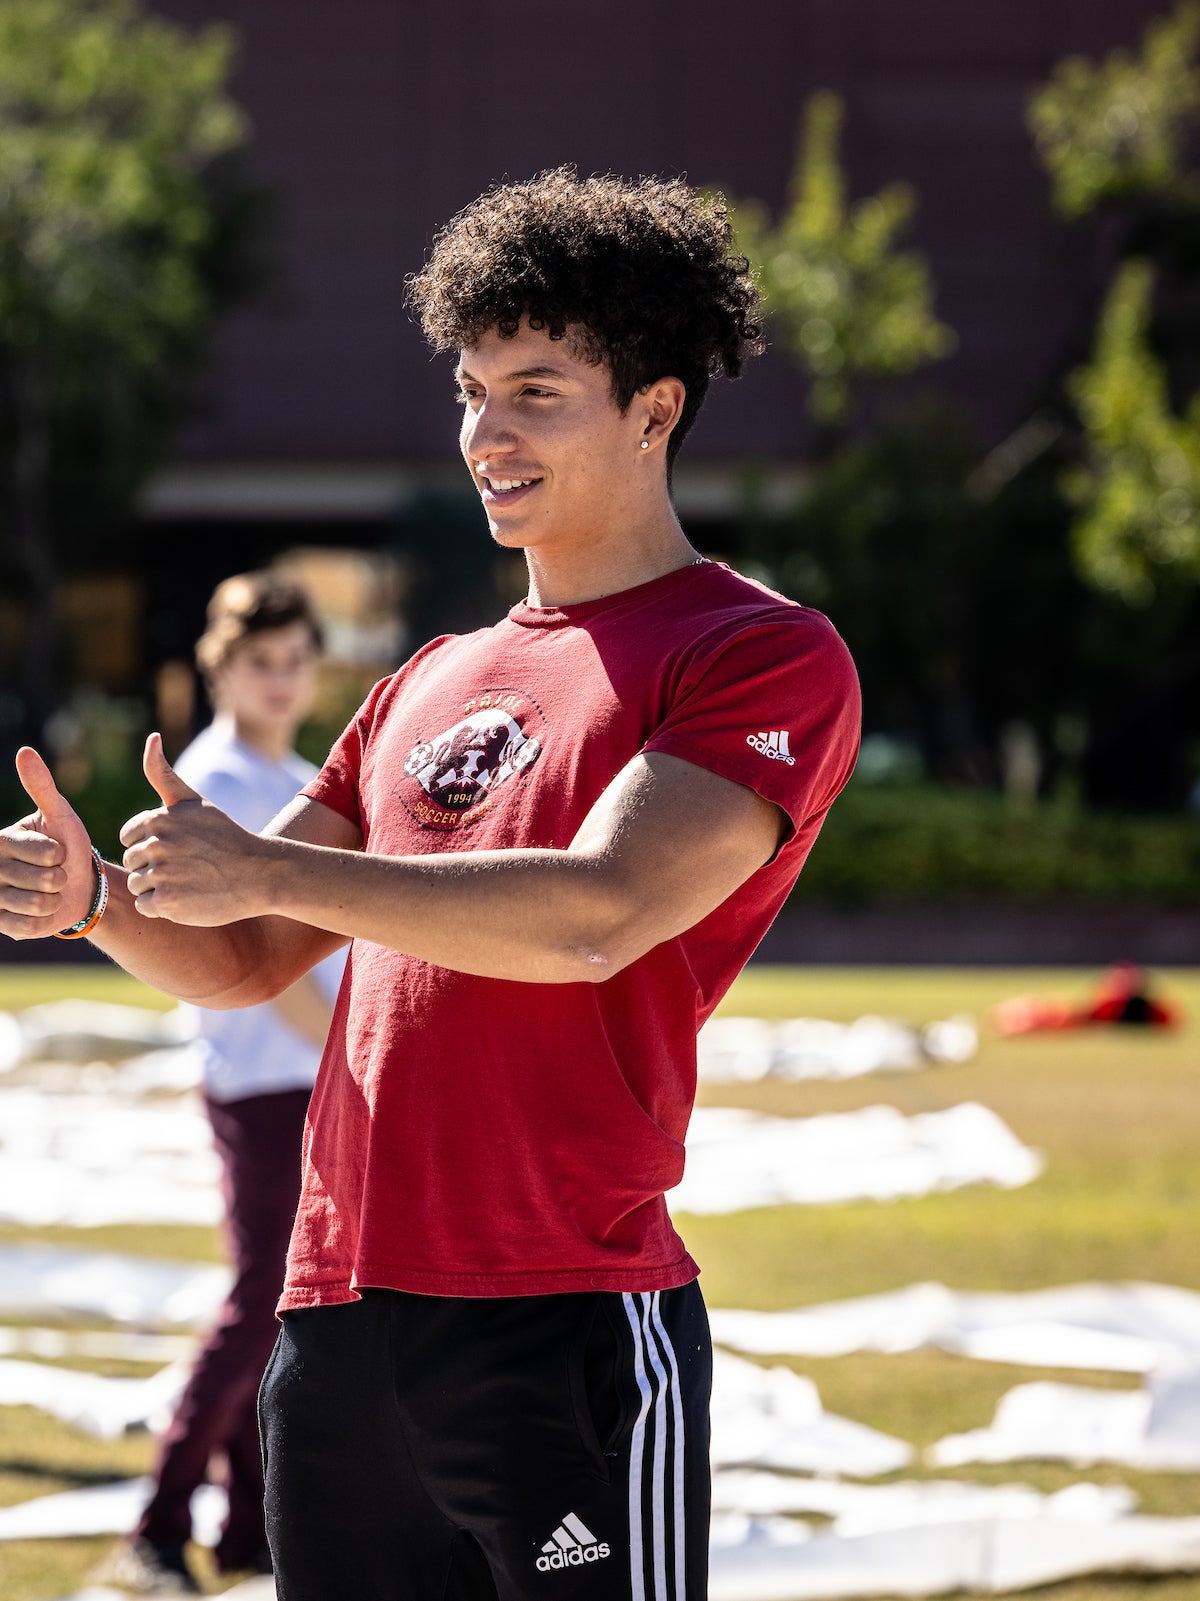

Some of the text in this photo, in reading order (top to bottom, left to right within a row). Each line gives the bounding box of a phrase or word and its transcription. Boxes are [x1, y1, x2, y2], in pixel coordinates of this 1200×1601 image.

[746, 734, 796, 766] adidas
[447, 793, 473, 804] 1994
[414, 800, 492, 824] SOCCER CLUB
[536, 1542, 611, 1571] adidas
